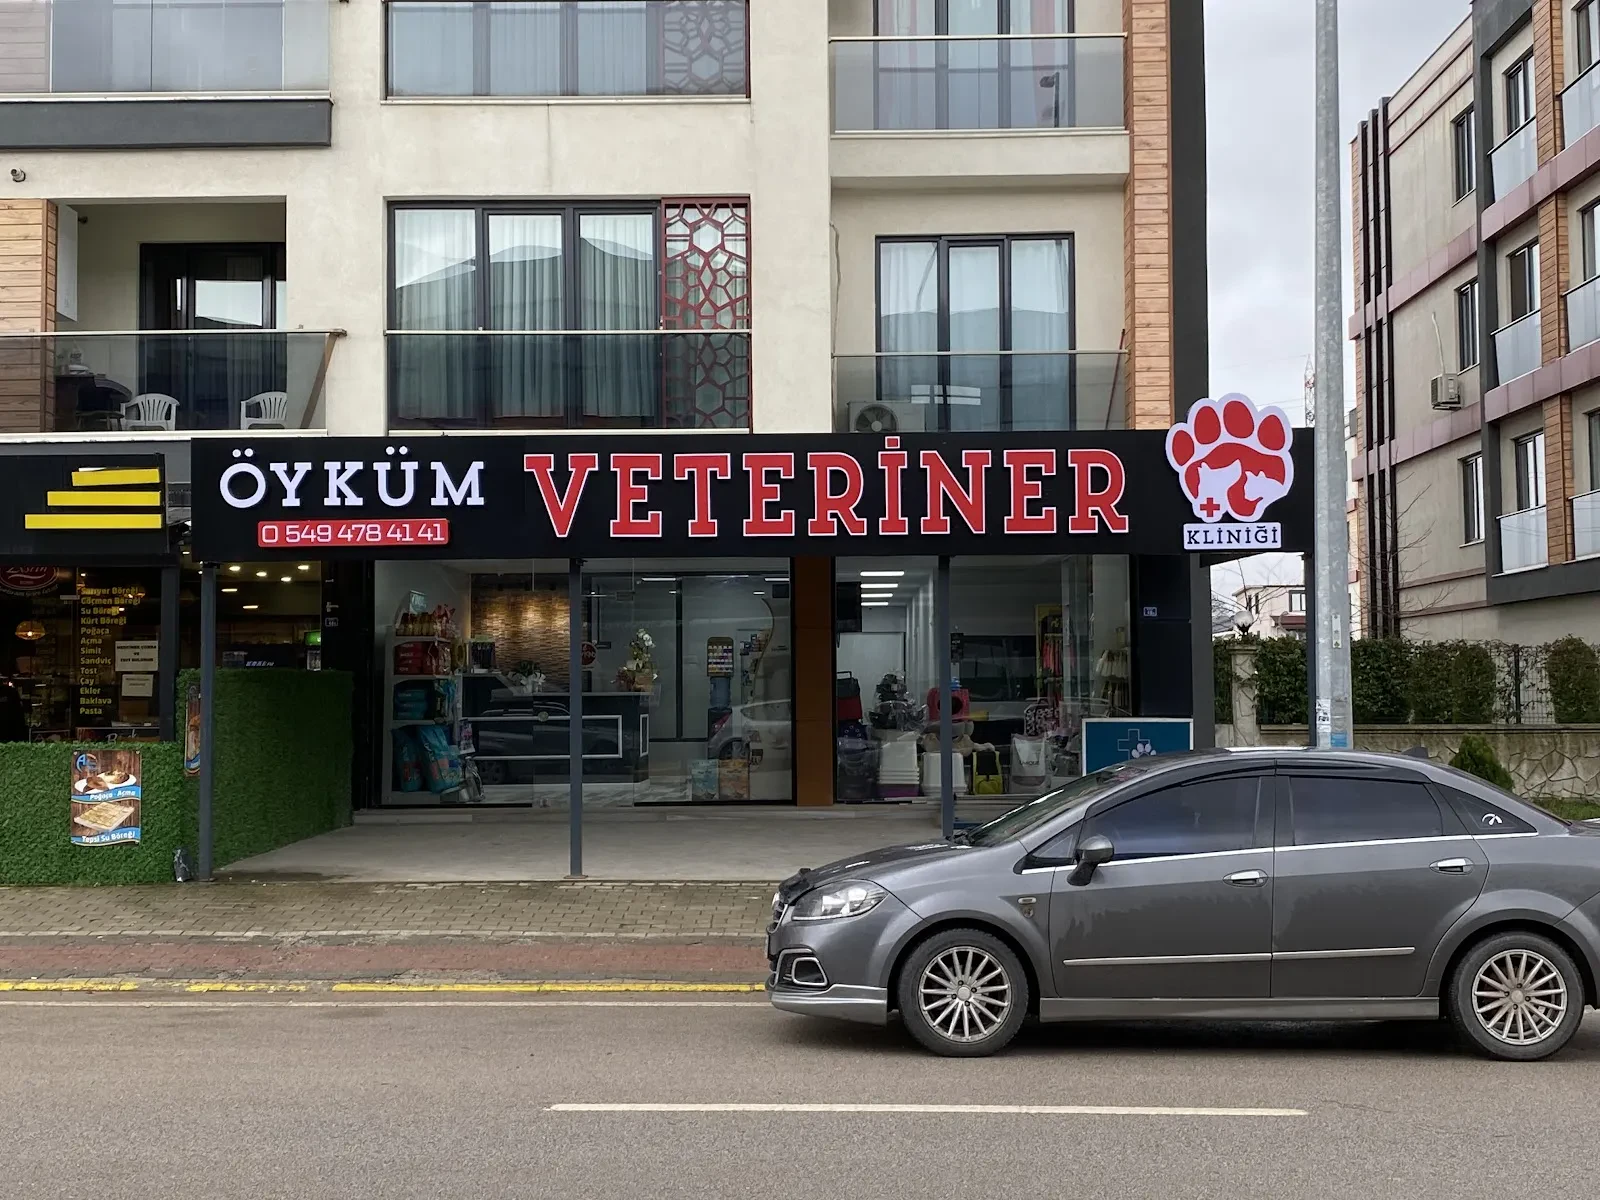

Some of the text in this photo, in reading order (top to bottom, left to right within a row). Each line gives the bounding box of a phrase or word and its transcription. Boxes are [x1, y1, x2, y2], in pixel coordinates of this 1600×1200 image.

[220, 436, 1129, 537] ÖYKÜM VETERİNER
[262, 523, 445, 543] 0 549 478 41 41
[1187, 525, 1279, 545] KLİNİĞİ
[80, 597, 141, 606] Göçmen Böreği
[80, 607, 91, 615] Su
[80, 616, 127, 626] Kürt Böreği
[80, 627, 110, 636] Poğaça
[80, 637, 103, 646] Açma
[80, 646, 102, 655] Simit
[80, 656, 112, 665] Sandviç
[80, 667, 98, 675] Tost
[80, 677, 95, 686] Çay
[79, 687, 101, 695] Ekler
[79, 697, 112, 705] Baklava
[79, 707, 103, 715] Pasta
[89, 790, 136, 801] Poğaça Açma
[81, 835, 100, 844] Tepsi
[101, 834, 110, 842] Su
